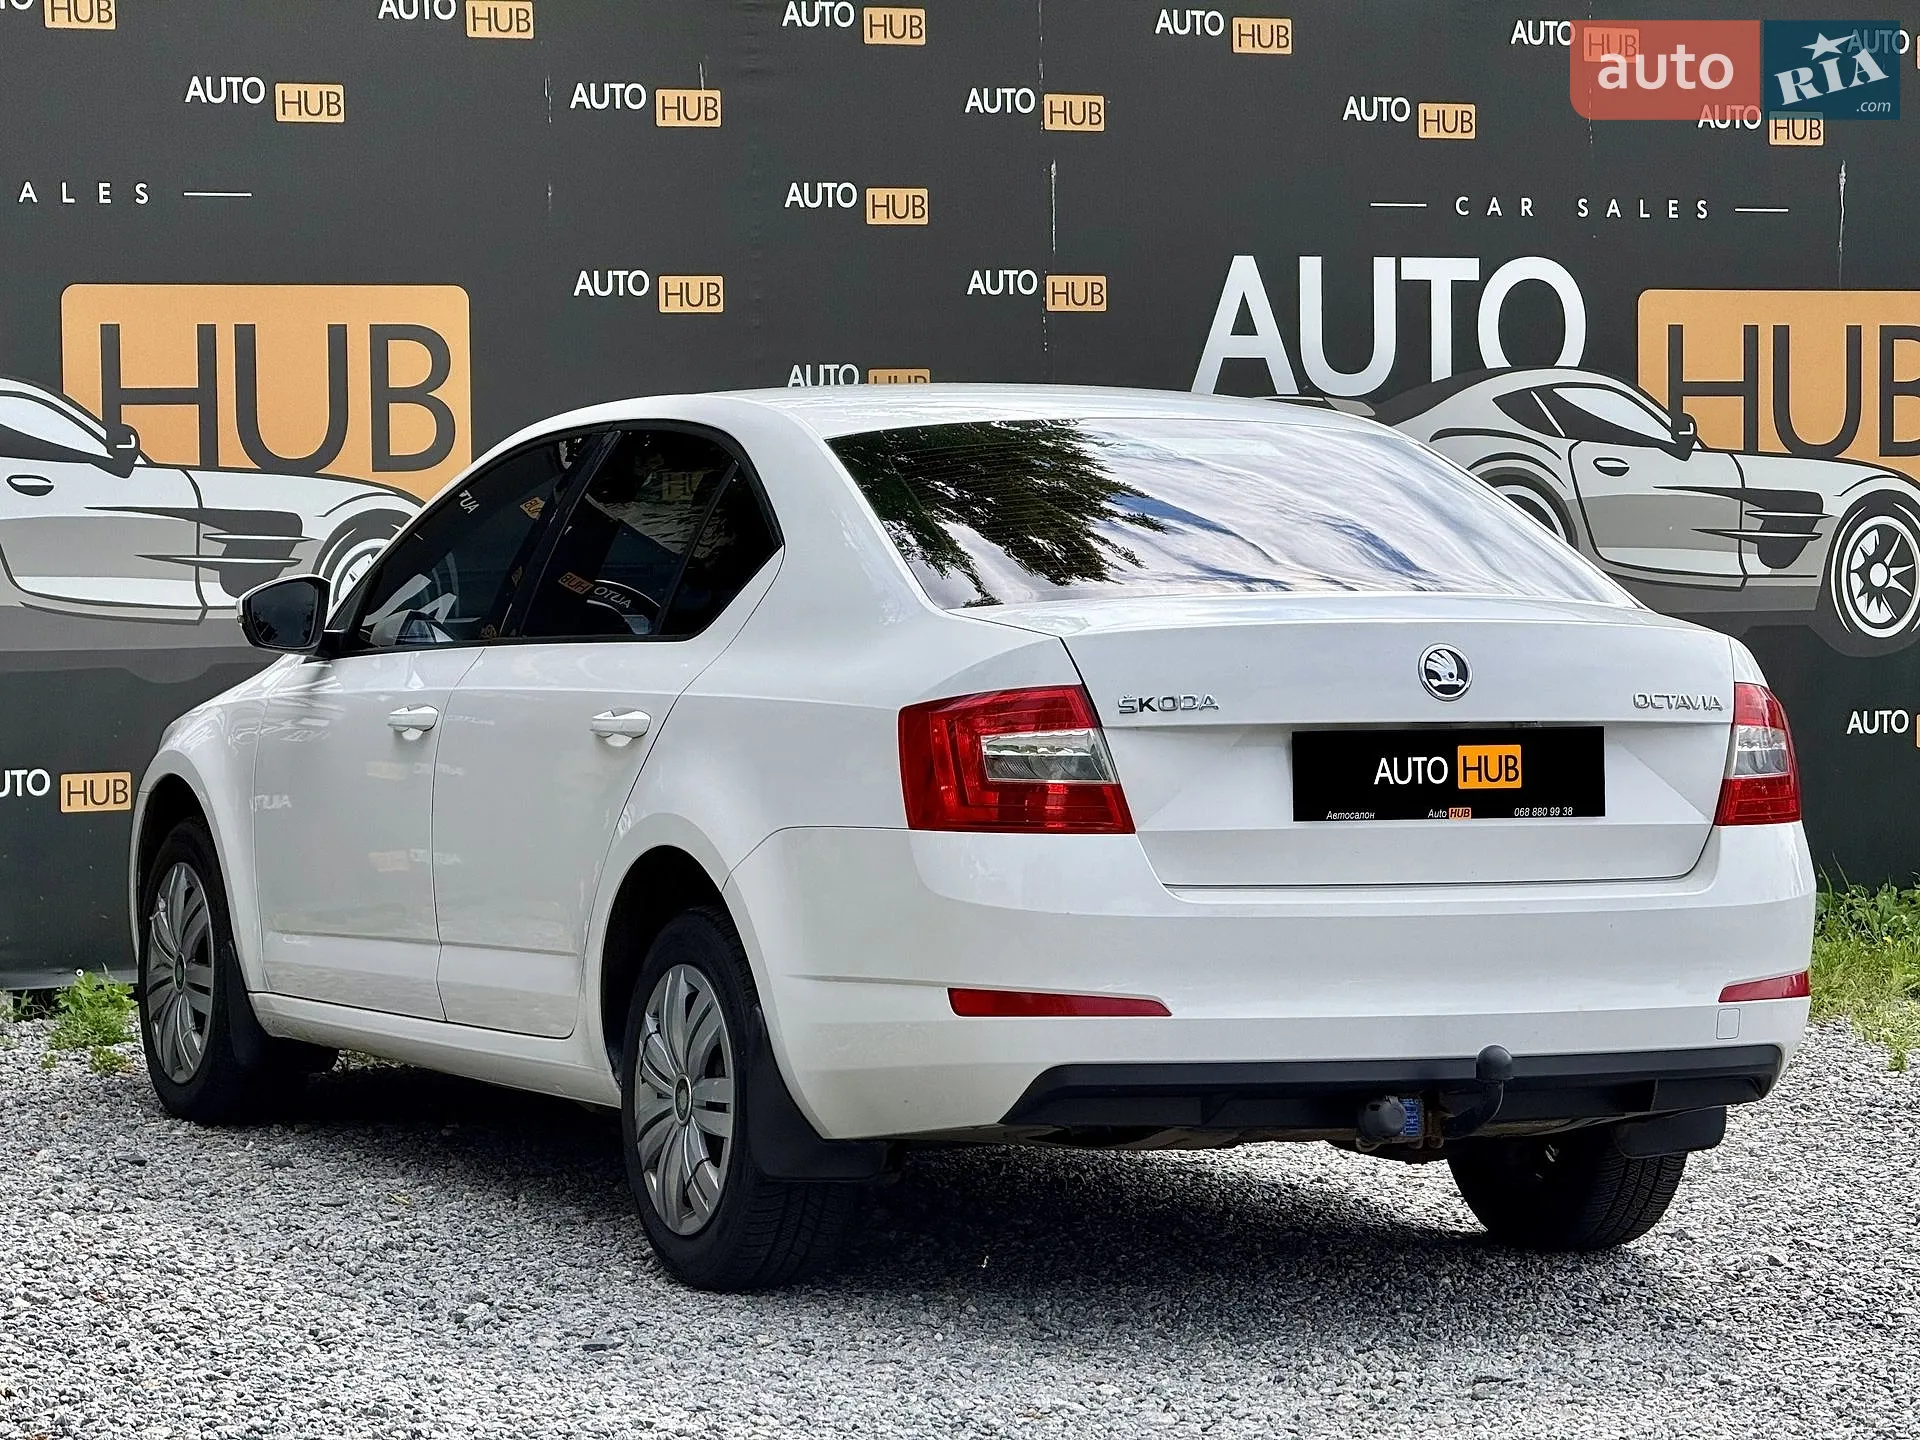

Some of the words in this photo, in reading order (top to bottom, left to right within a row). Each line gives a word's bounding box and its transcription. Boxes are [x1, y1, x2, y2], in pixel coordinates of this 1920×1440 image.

[51, 0, 114, 23] HUB
[378, 0, 456, 20] AUTO
[472, 6, 531, 33] HUB
[782, 0, 854, 27] AUTO
[870, 14, 924, 40] HUB
[1155, 9, 1224, 36] AUTO
[1238, 24, 1290, 49] HUB
[1511, 20, 1576, 46] AUTO
[185, 76, 265, 104] AUTO
[281, 91, 342, 117] HUB
[570, 83, 646, 109] AUTO
[662, 96, 719, 122] HUB
[965, 88, 1036, 114] AUTO
[1049, 101, 1103, 126] HUB
[1343, 96, 1410, 123] AUTO
[1424, 110, 1474, 134] HUB
[1698, 105, 1761, 130] AUTO
[1773, 117, 1821, 141] HUB
[785, 182, 857, 208] AUTO
[872, 195, 926, 220] HUB
[1456, 197, 1533, 217] CAR
[1578, 198, 1709, 219] SALES
[574, 270, 649, 297] AUTO
[665, 282, 721, 307] HUB
[967, 270, 1037, 296] AUTO
[1052, 282, 1104, 307] HUB
[1192, 255, 1588, 397] AUTO
[788, 364, 859, 387] AUTO
[100, 323, 457, 474] HUB
[1118, 694, 1220, 714] ŠKODA
[1633, 693, 1724, 711] OCTAVIA
[1846, 709, 1909, 734] AUTO
[1374, 756, 1448, 785] AUTO
[1462, 755, 1520, 783] HUB
[67, 779, 128, 806] HUB
[1326, 810, 1375, 820] Автосалон
[1428, 809, 1447, 818] Auto
[1450, 808, 1470, 818] HUB
[1514, 808, 1530, 817] 068
[1532, 807, 1548, 817] 880
[1550, 807, 1561, 816] 99
[1562, 806, 1573, 816] 38
